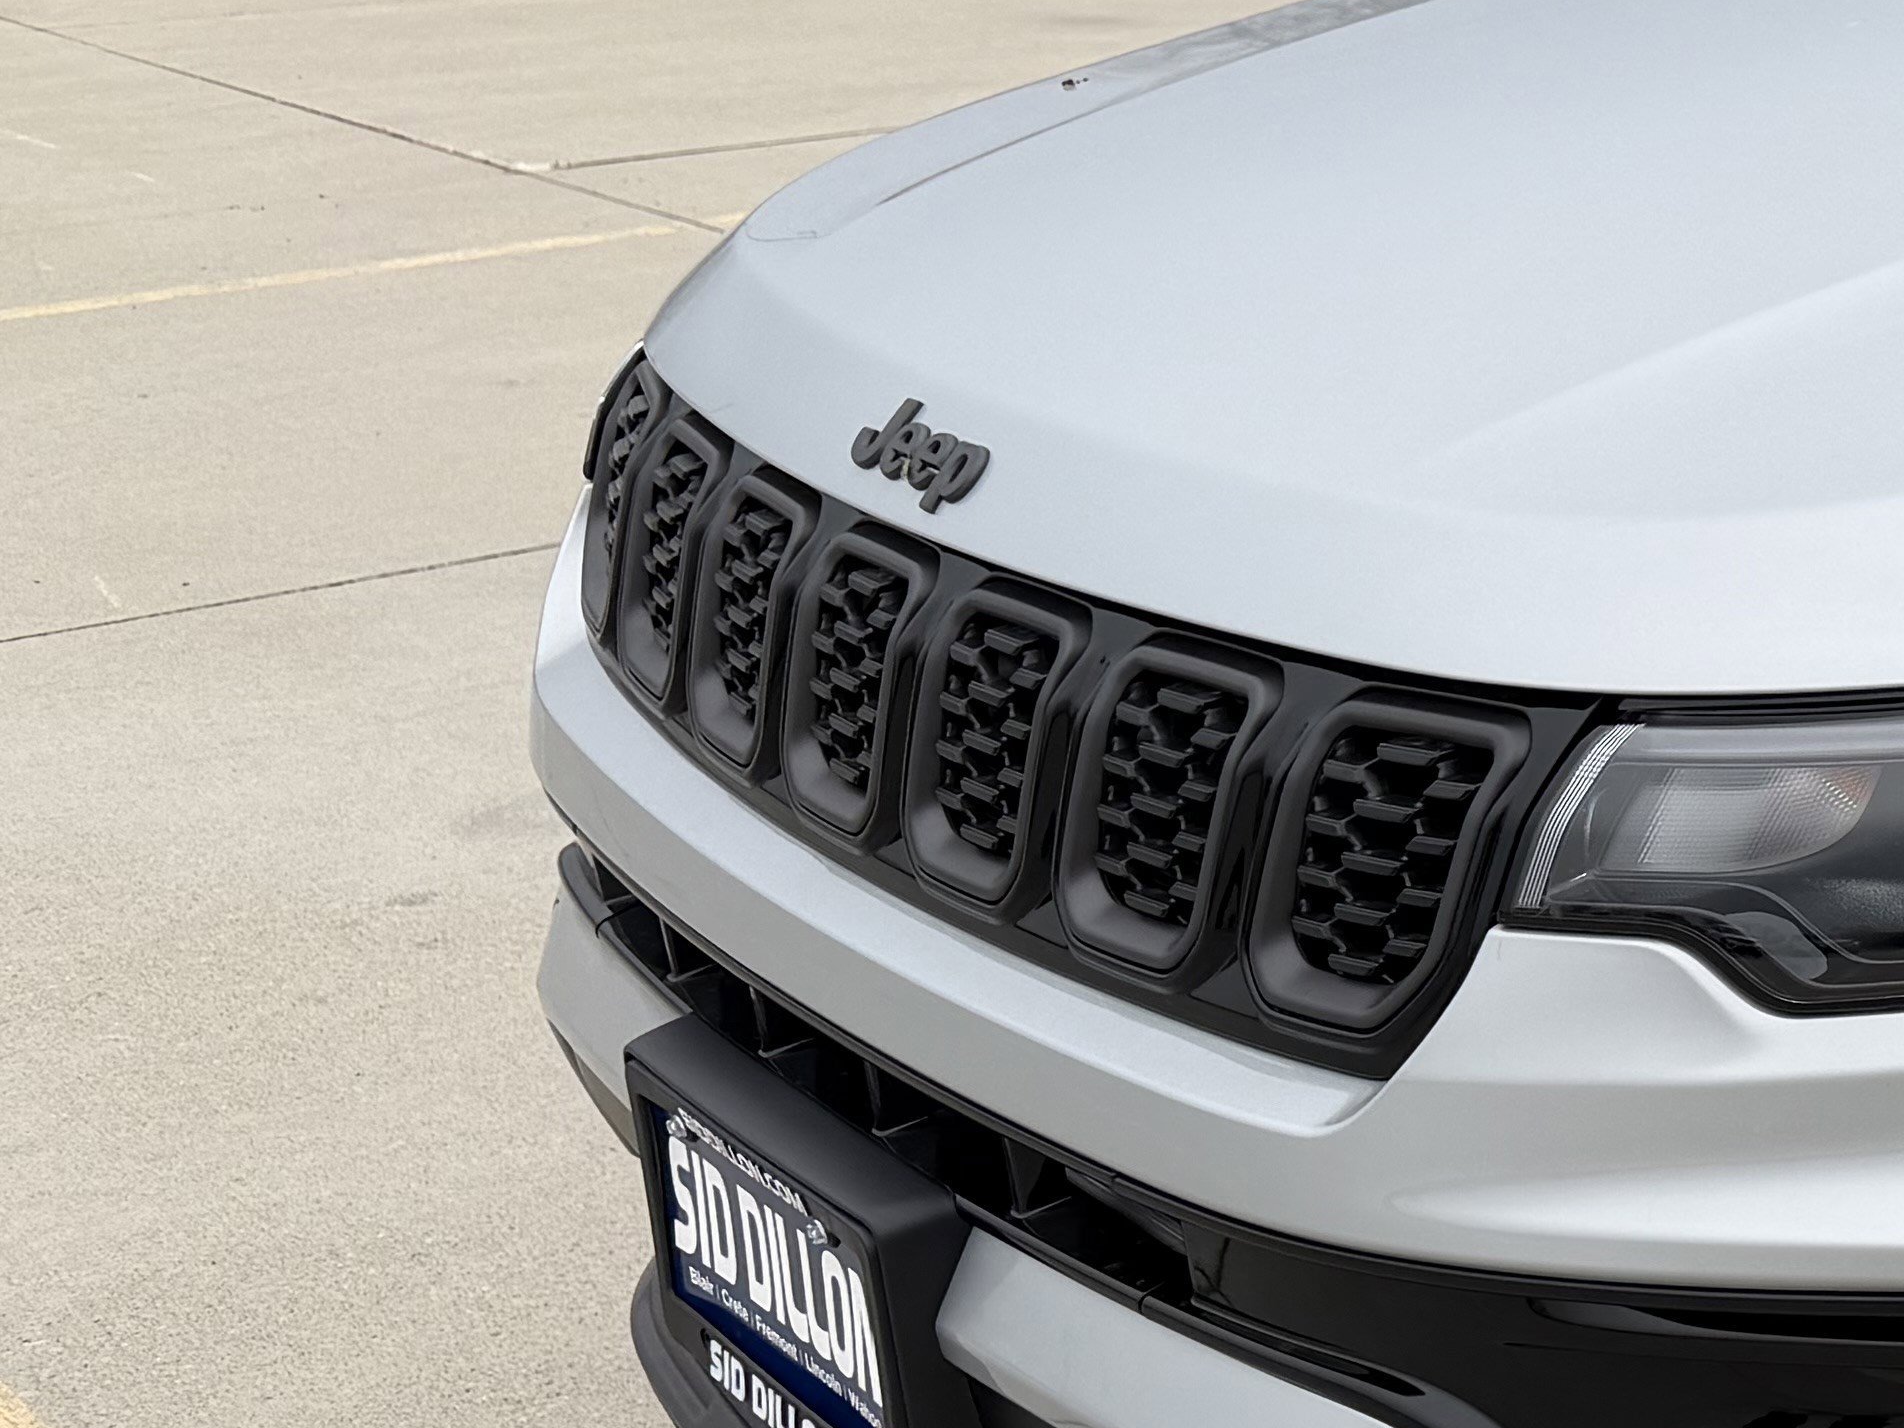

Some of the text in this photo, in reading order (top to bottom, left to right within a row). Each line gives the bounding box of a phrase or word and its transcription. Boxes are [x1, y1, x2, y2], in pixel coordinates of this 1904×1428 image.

[851, 398, 990, 514] Jeep
[668, 1135, 883, 1408] SID DILLON
[709, 1338, 746, 1402] SID
[721, 1288, 750, 1323] Crete
[755, 1313, 799, 1362] Fremont
[804, 1352, 843, 1397] Lincoln
